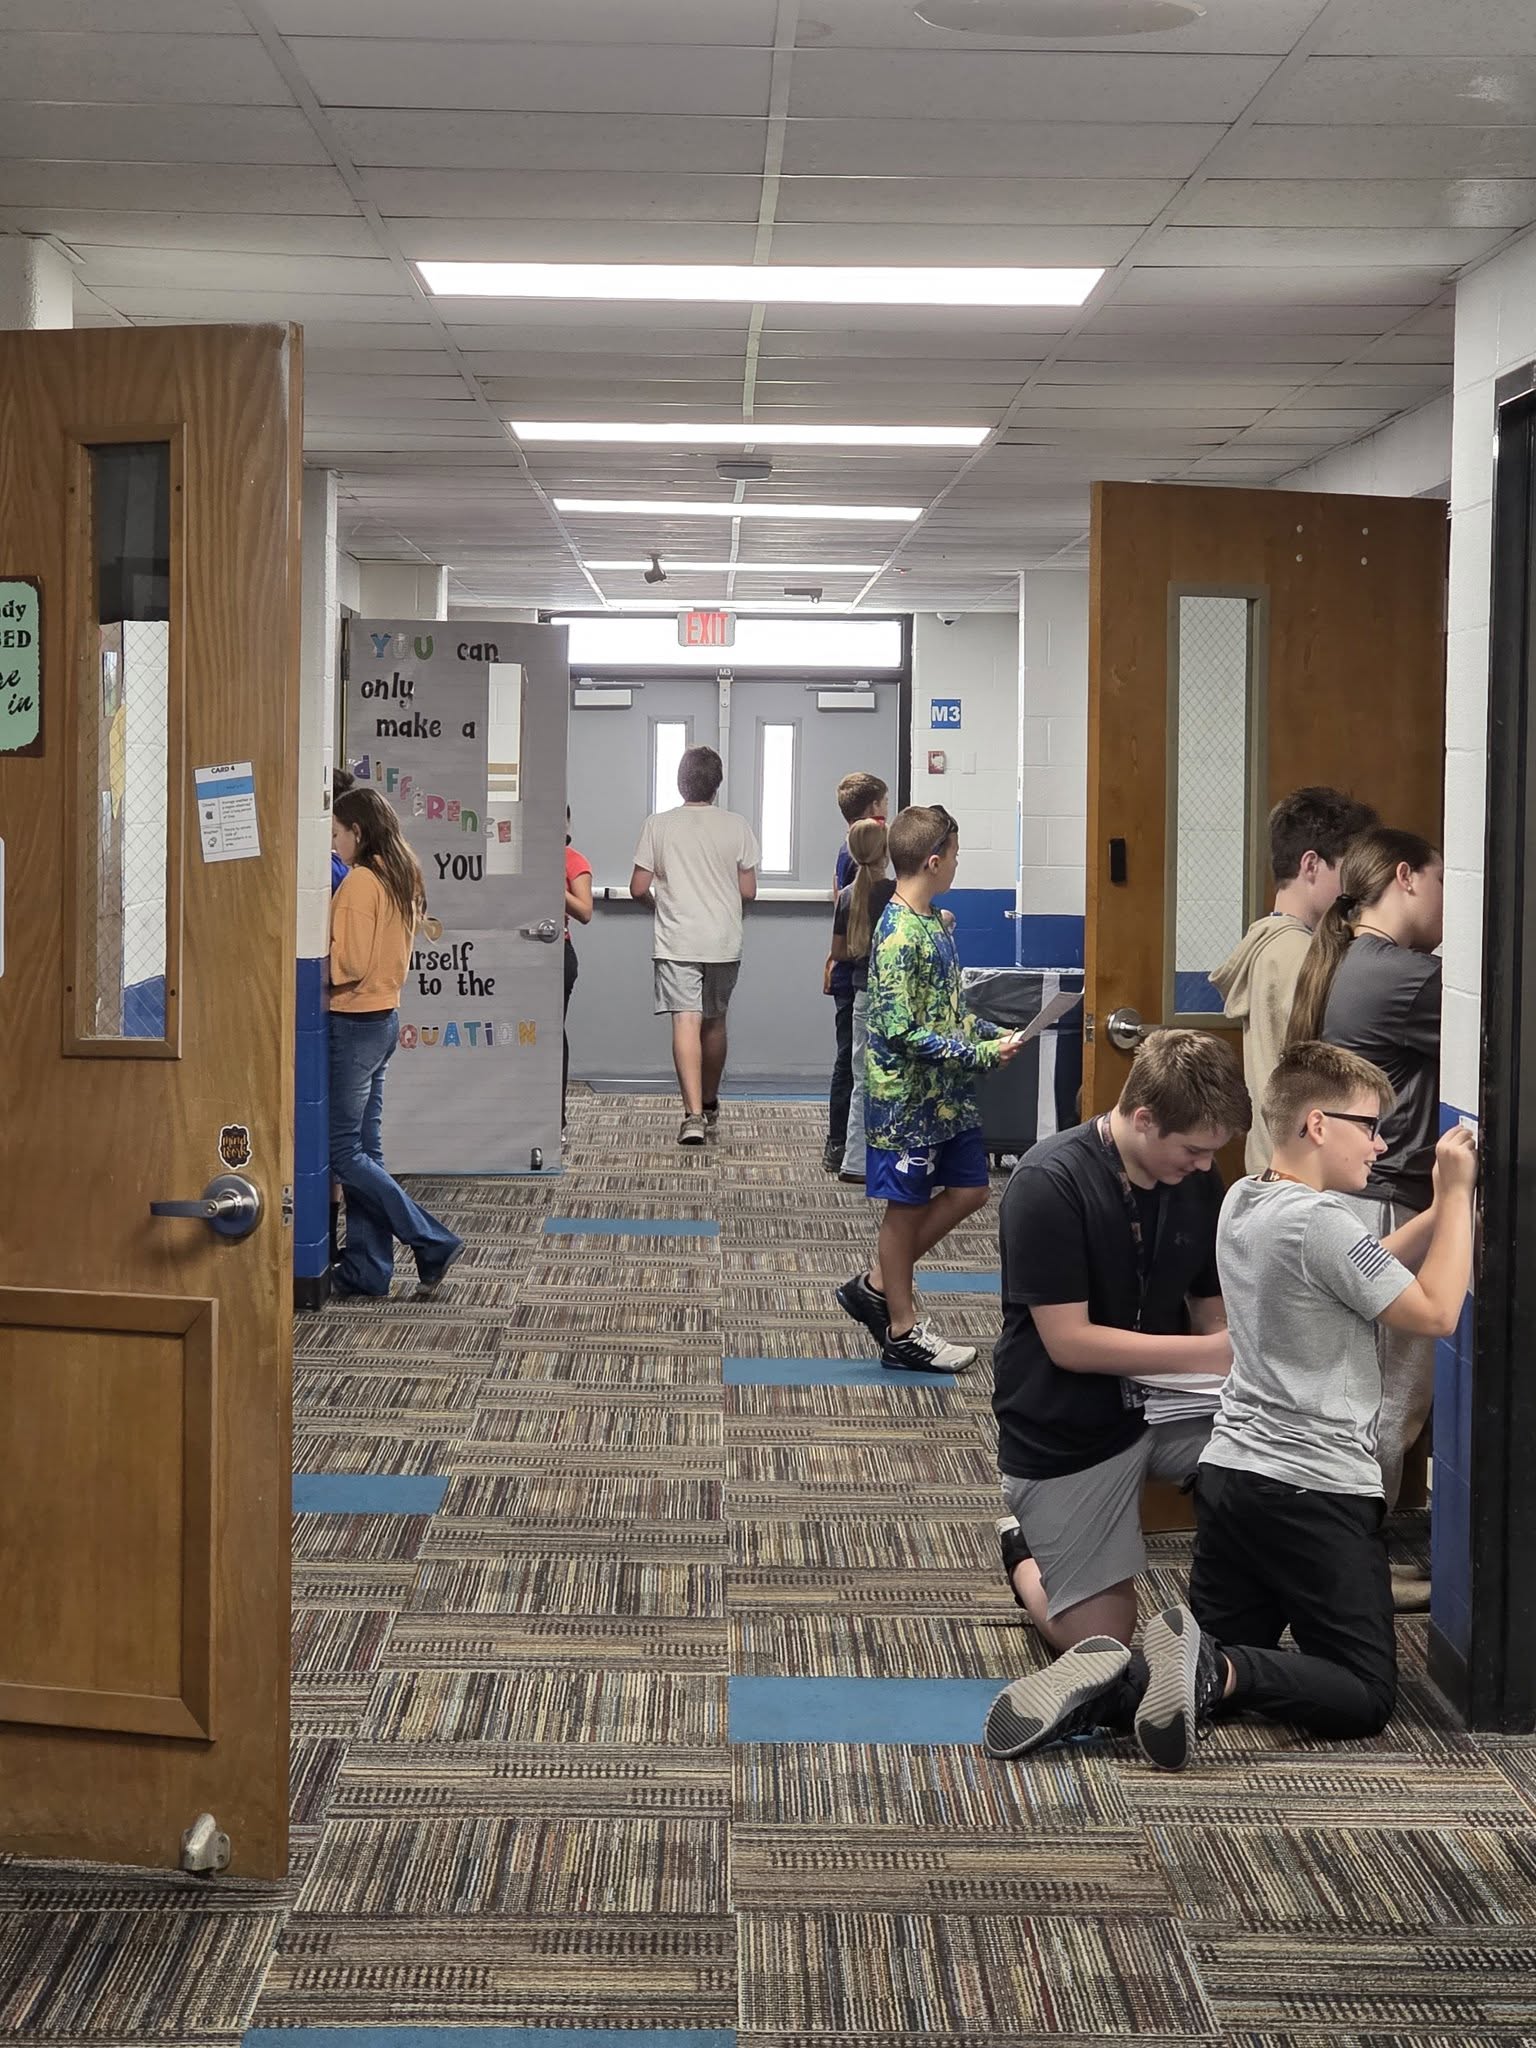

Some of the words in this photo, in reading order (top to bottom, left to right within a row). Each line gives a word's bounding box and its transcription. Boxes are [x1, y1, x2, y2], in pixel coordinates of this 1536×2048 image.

[0, 629, 32, 648] ED
[687, 613, 728, 644] EXIT
[370, 633, 434, 661] YOU
[457, 642, 499, 663] can
[361, 671, 414, 709] only
[8, 693, 34, 715] in
[931, 705, 961, 722] M3
[376, 711, 442, 739] make
[462, 721, 476, 739] a
[211, 766, 229, 774] CARD
[433, 853, 483, 882] YOU
[418, 973, 442, 996] to
[457, 970, 496, 997] the
